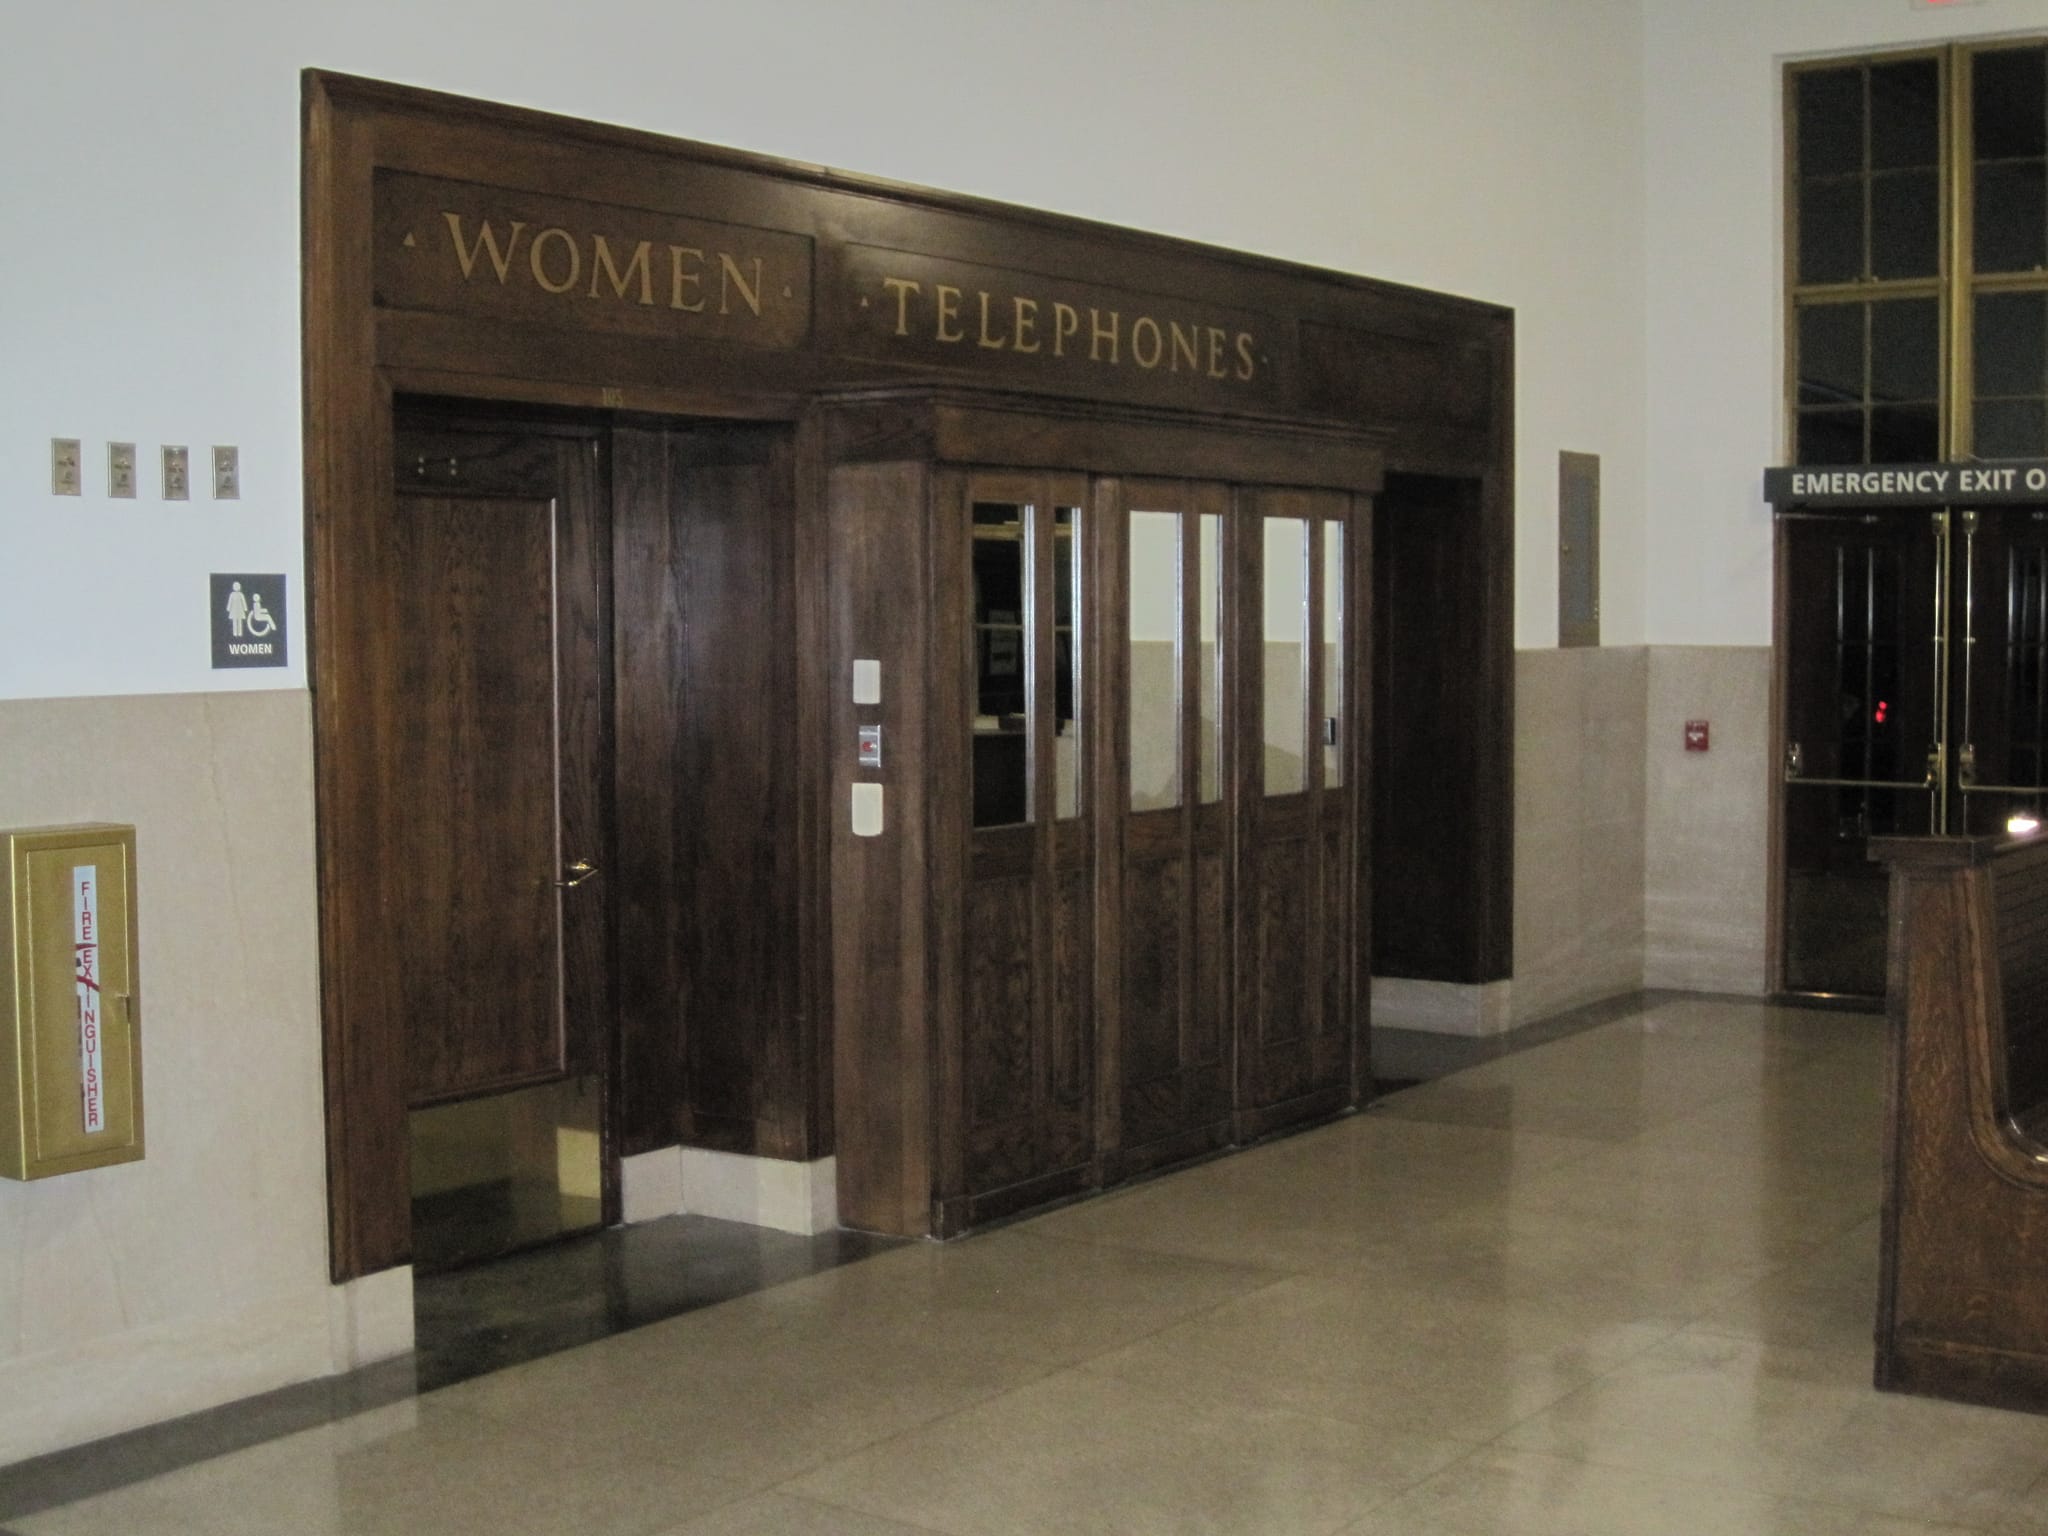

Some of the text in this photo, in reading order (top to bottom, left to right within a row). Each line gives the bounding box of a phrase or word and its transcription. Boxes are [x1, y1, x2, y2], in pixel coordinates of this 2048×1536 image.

[442, 211, 763, 317] WOMEN
[883, 277, 1255, 382] TELEPHONES
[1792, 470, 1949, 495] EMERGENCY
[1959, 469, 2017, 492] EXIT
[228, 643, 273, 655] WOMEN
[81, 881, 92, 940] FIRE
